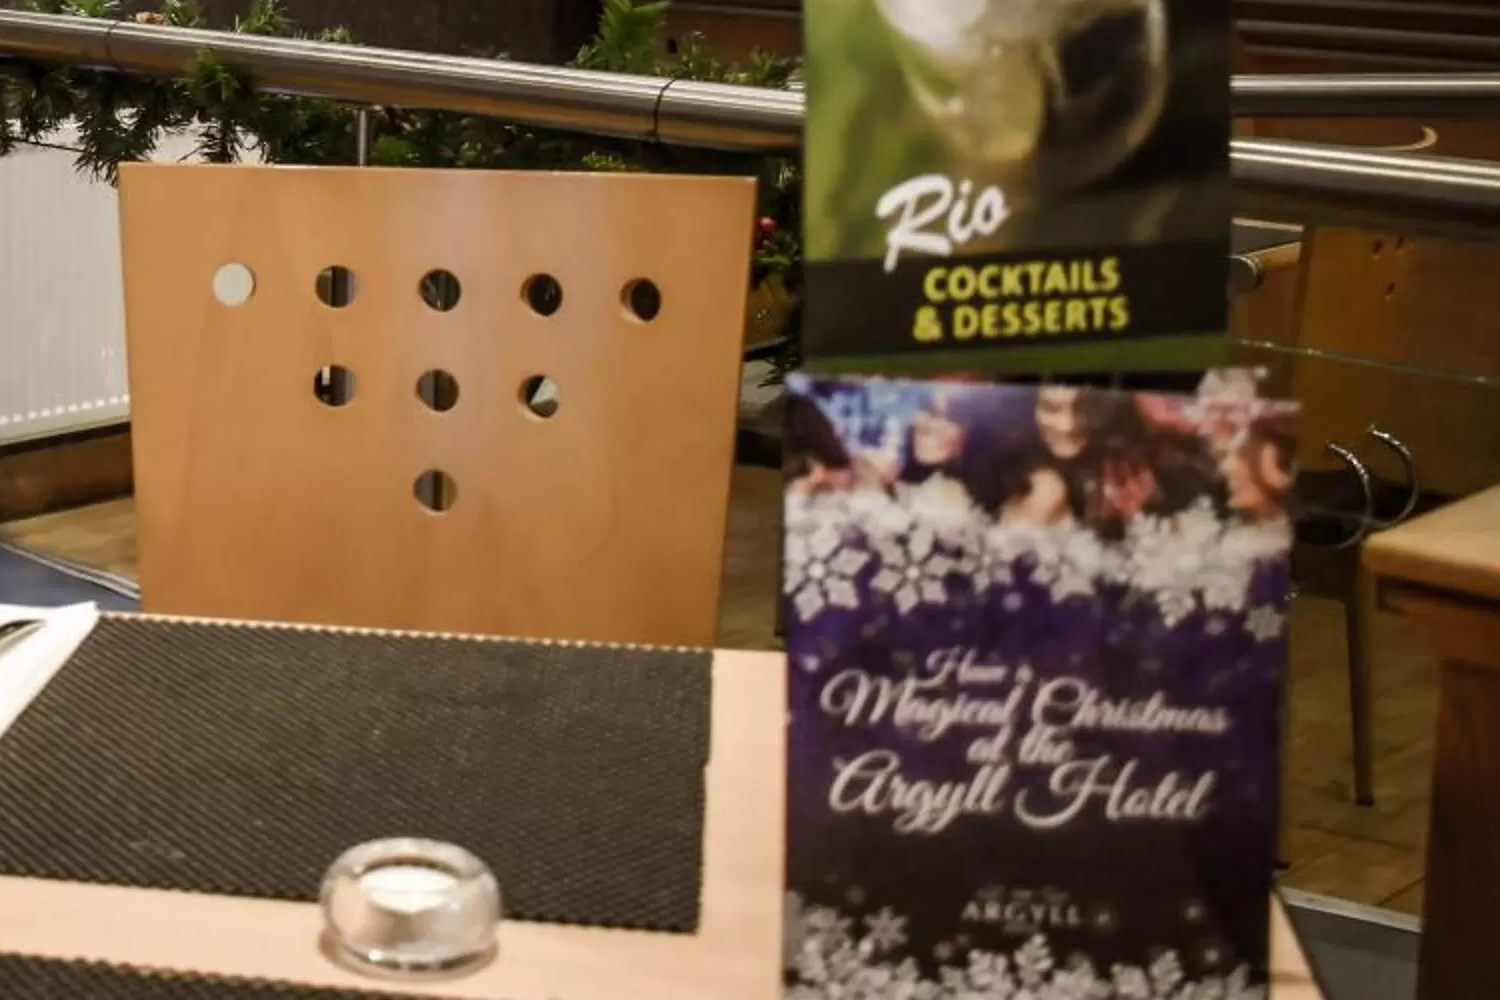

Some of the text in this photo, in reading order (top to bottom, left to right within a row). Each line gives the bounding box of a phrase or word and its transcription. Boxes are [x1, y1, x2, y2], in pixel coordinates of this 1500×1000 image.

[876, 174, 1010, 273] Rio
[923, 257, 1120, 301] COCKTAILS
[912, 297, 1129, 342] & DESSERTS
[820, 669, 1229, 741] Magical Christmas
[829, 749, 1216, 834] Argyll Hotel
